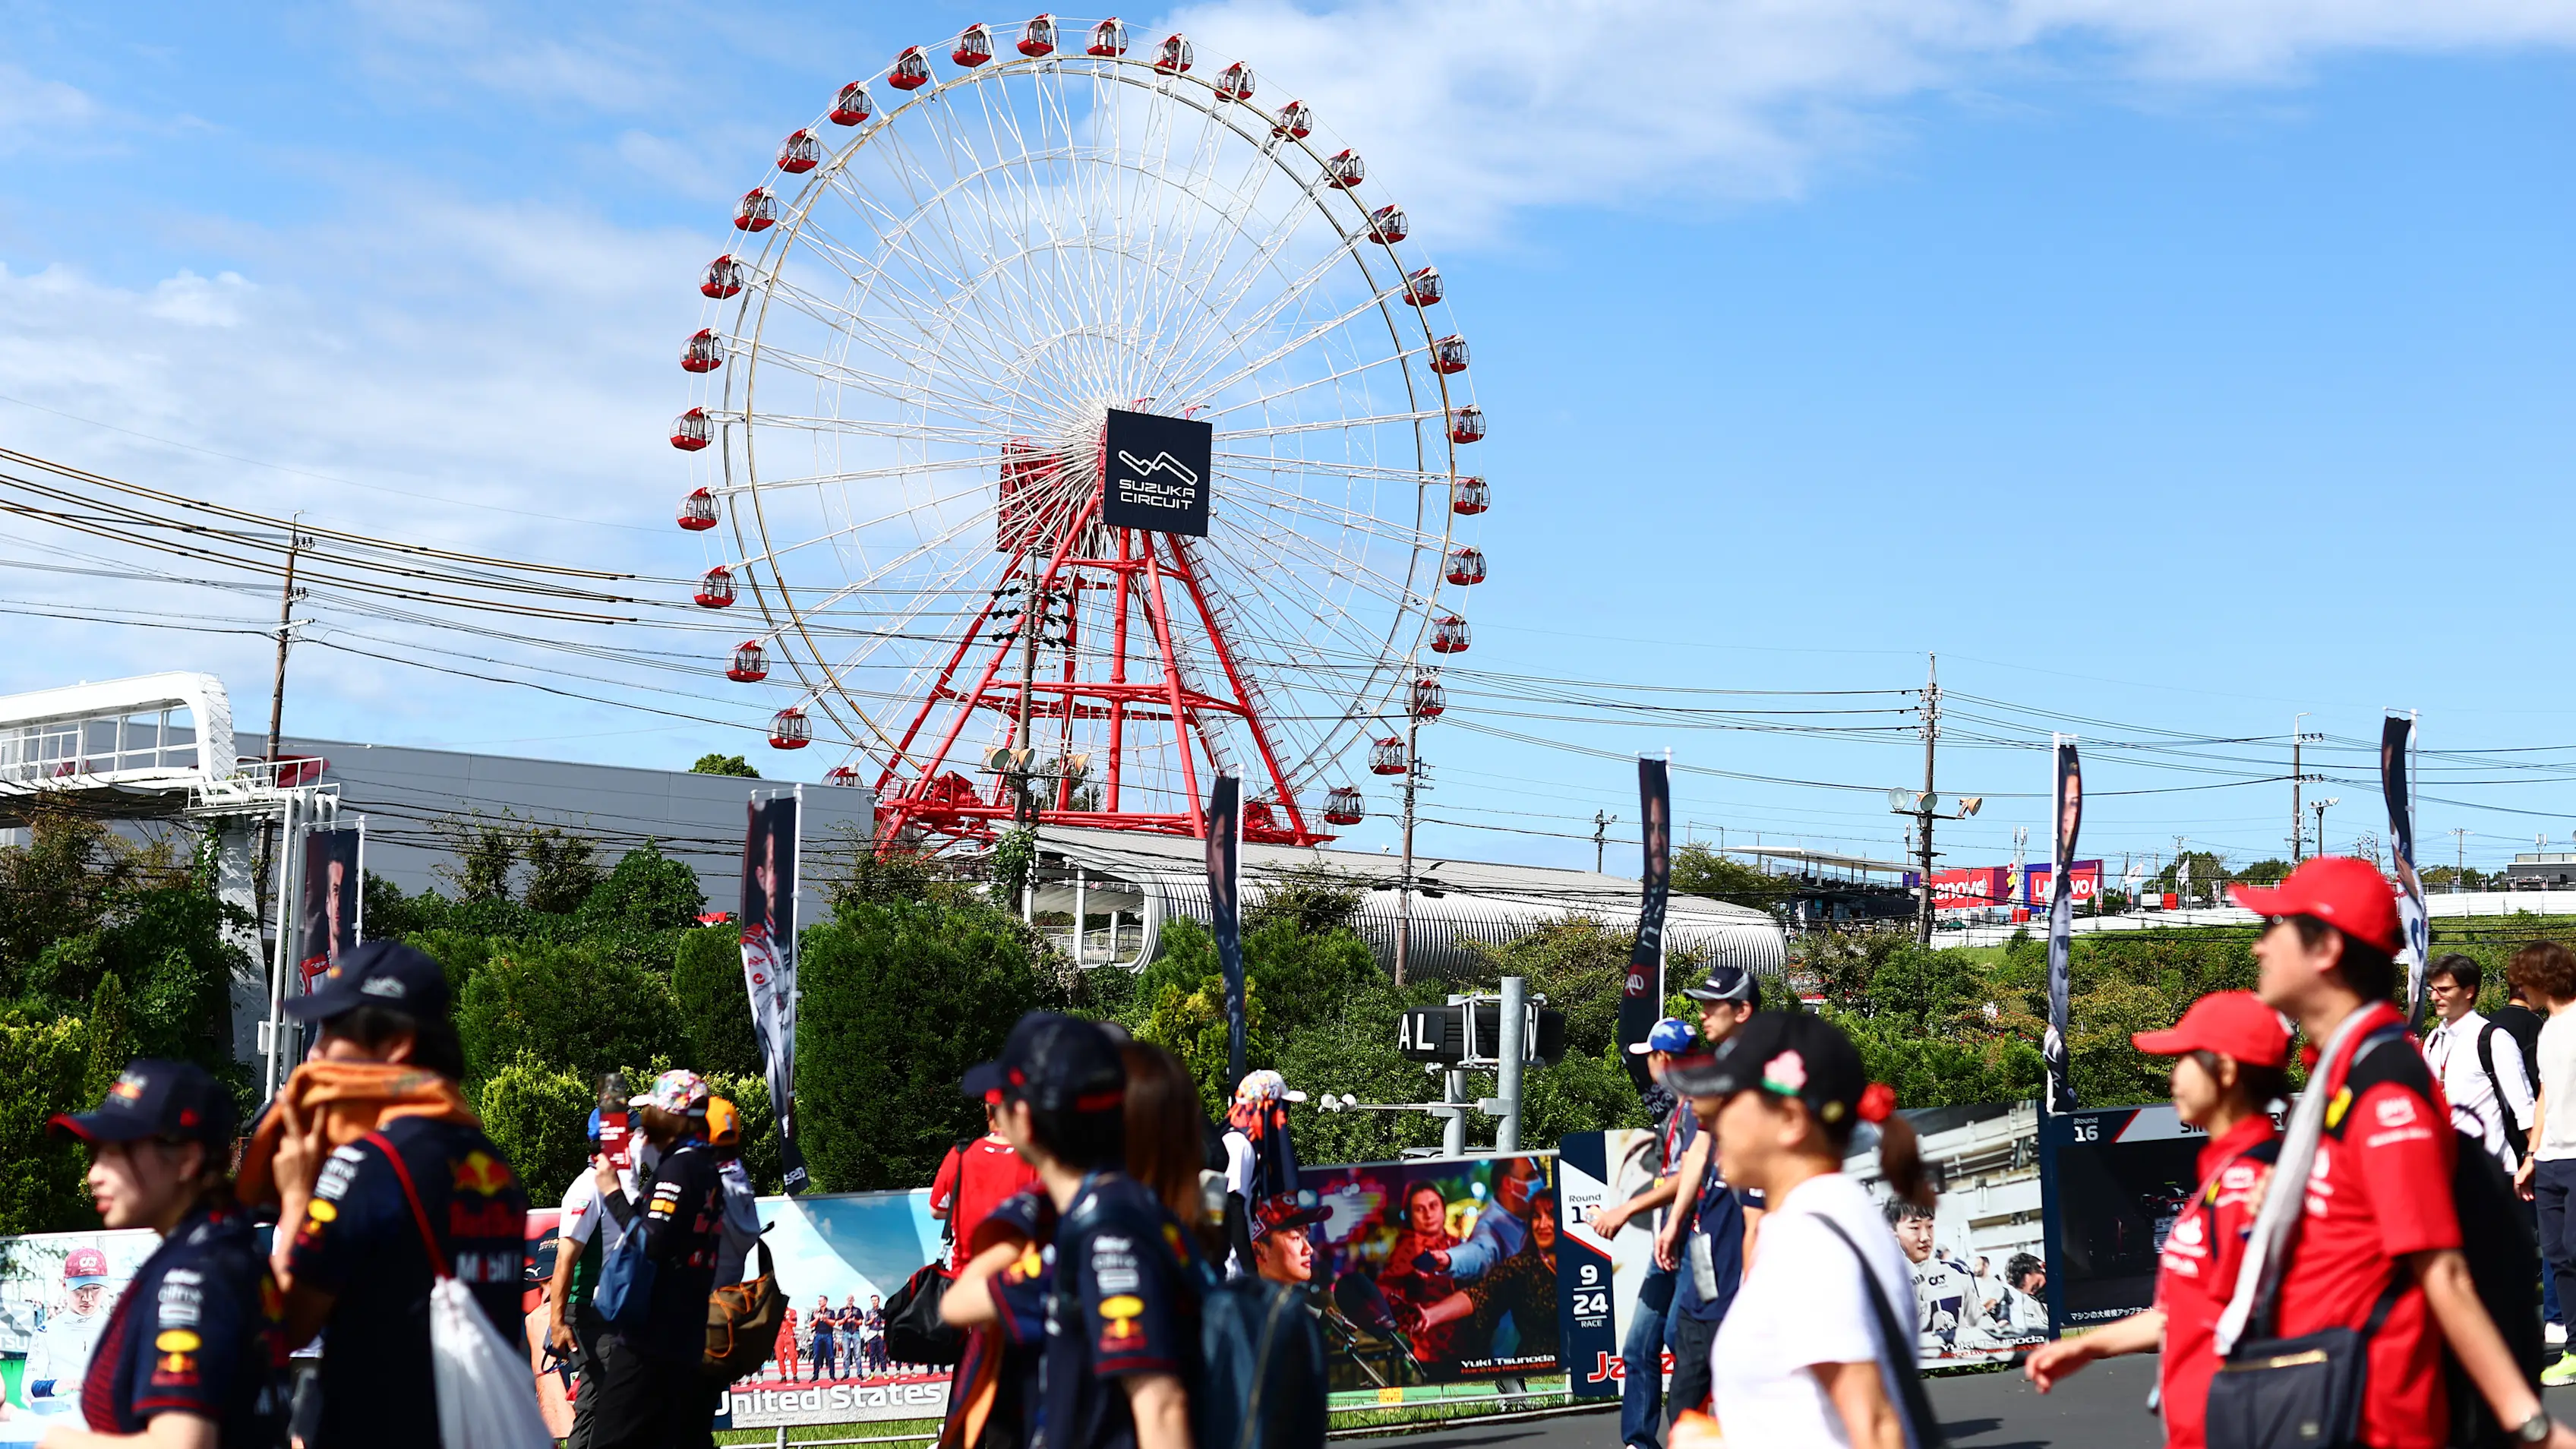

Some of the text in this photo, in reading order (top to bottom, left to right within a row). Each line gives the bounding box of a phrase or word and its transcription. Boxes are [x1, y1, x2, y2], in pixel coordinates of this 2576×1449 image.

[1119, 478, 1195, 498] SUZUKA
[1120, 491, 1193, 510] CIRCUIT
[1398, 1013, 1435, 1050] AL
[2073, 1116, 2098, 1125] Round
[2074, 1125, 2098, 1142] 16
[1569, 1194, 1602, 1202] Round
[1580, 1264, 1599, 1285] 9
[1573, 1293, 1608, 1315] 24
[1580, 1319, 1603, 1328] RACE
[1940, 1334, 2045, 1351] Yuki Tsunoda
[1461, 1354, 1555, 1368] Yuki Tsunoda
[829, 1382, 942, 1410] States
